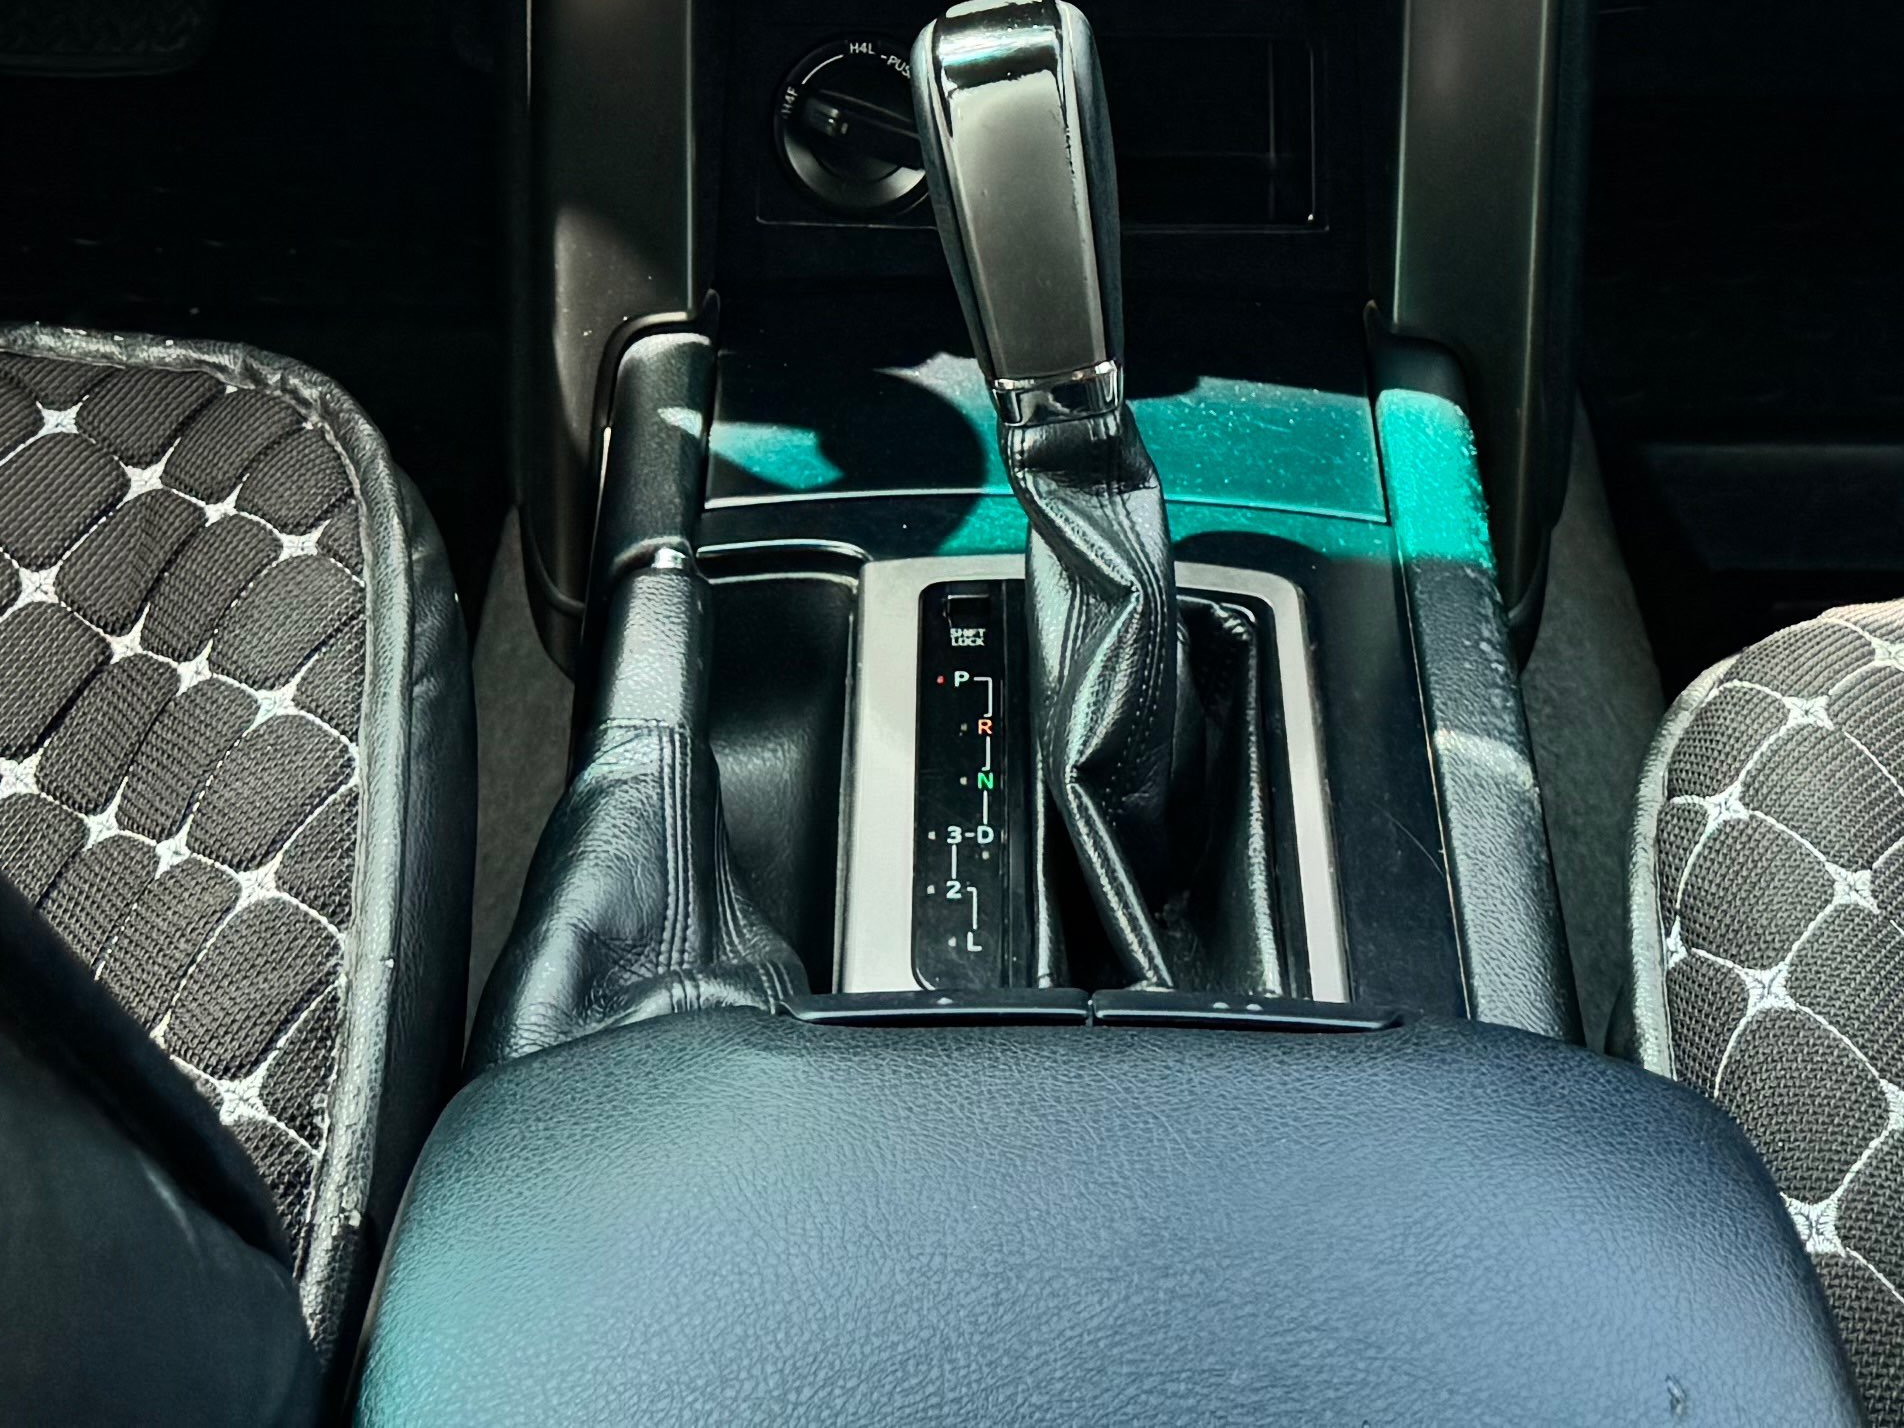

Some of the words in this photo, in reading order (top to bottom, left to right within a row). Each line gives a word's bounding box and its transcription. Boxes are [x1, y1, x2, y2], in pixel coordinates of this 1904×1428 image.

[849, 42, 876, 55] H4L
[781, 85, 799, 120] H4F
[950, 628, 986, 637] SHIFT
[951, 637, 985, 646] LOCK
[954, 670, 970, 687] P
[978, 719, 993, 735] R
[977, 772, 994, 790] N
[946, 880, 962, 899] 2
[967, 931, 983, 952] L
